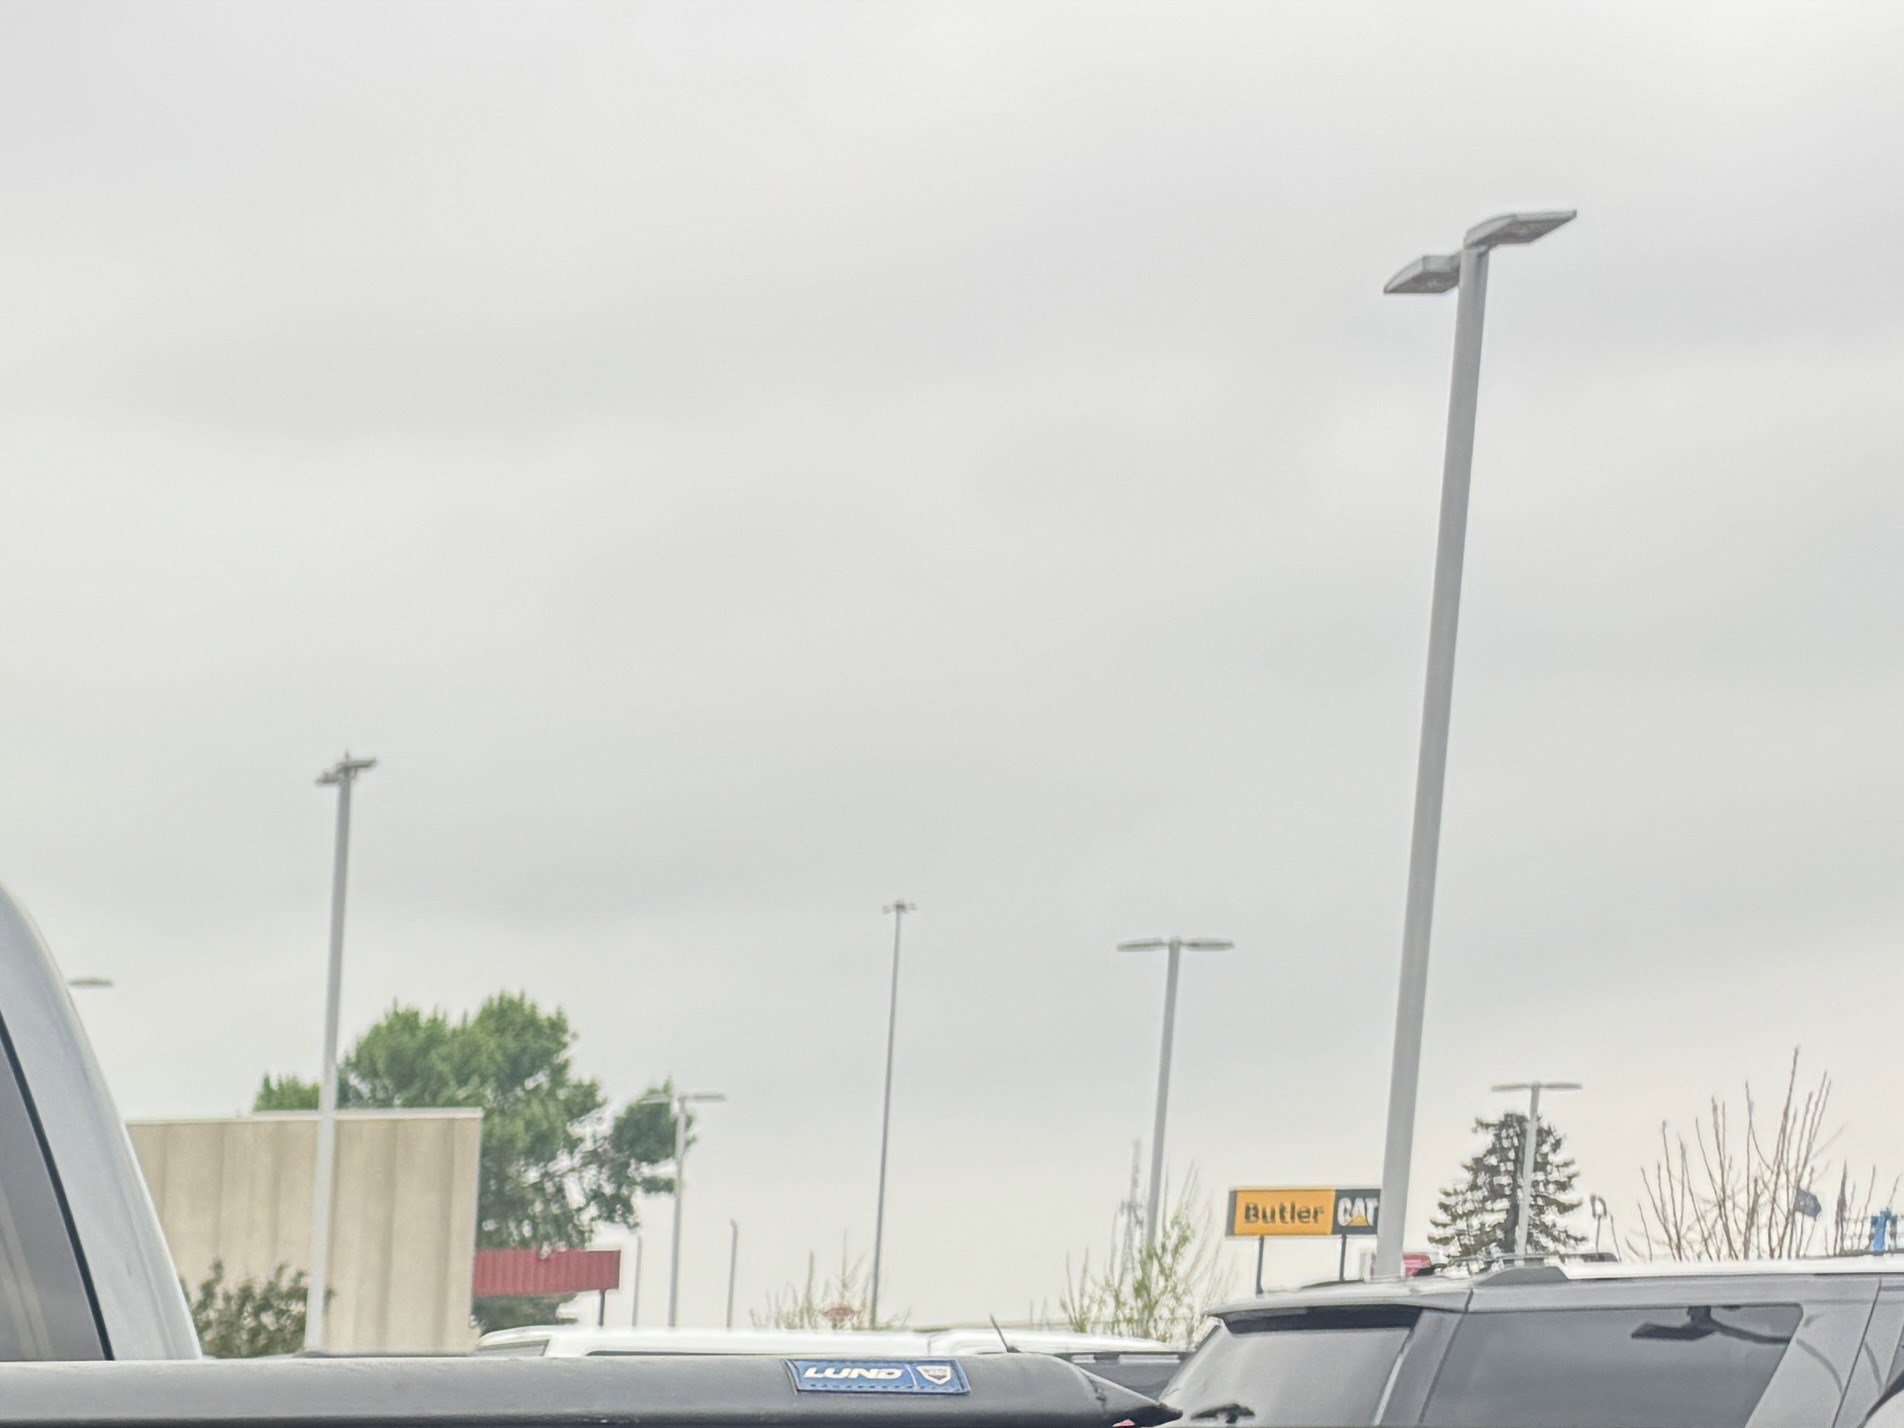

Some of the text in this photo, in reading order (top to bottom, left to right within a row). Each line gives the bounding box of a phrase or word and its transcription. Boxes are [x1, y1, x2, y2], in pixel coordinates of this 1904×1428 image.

[1243, 1197, 1379, 1227] Butler CAT
[803, 1366, 902, 1380] LUND
